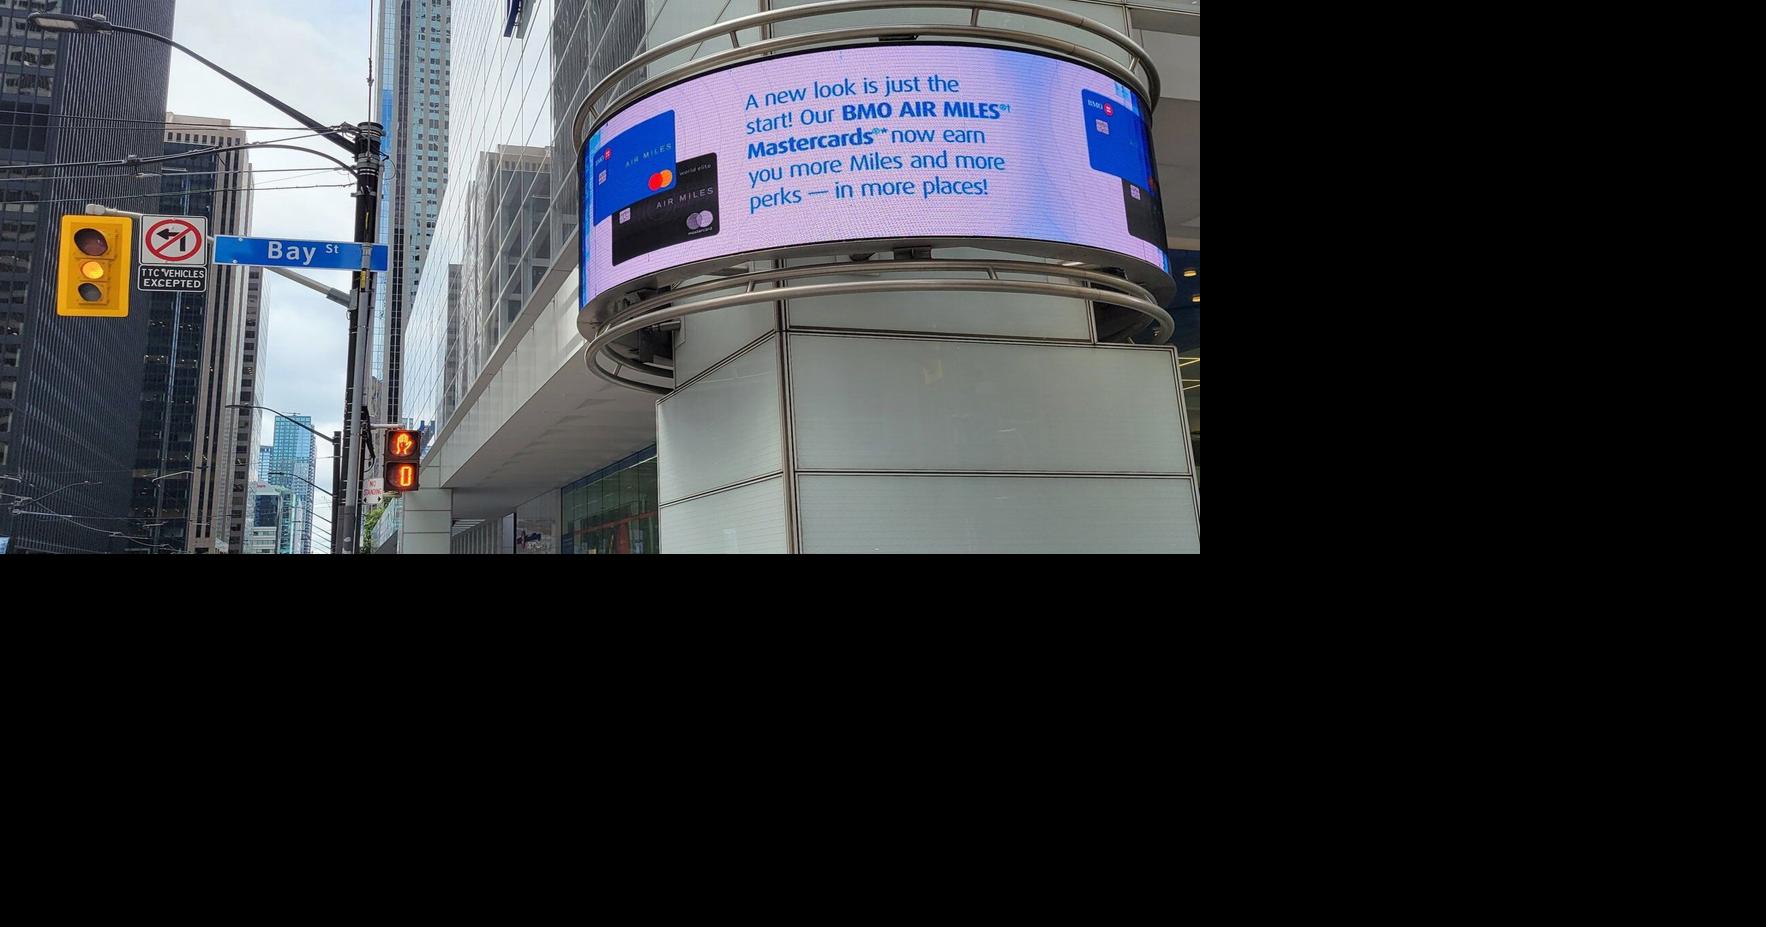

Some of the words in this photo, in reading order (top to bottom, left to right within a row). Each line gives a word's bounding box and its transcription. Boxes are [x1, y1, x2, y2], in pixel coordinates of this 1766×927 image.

[745, 94, 759, 111] A
[765, 87, 806, 106] new
[814, 78, 856, 99] look
[863, 77, 878, 94] is
[884, 75, 921, 97] just
[927, 74, 959, 93] the
[746, 111, 793, 135] start!
[800, 108, 835, 126] Our
[842, 101, 892, 122] BMO
[899, 101, 937, 118] AIR
[891, 128, 935, 144] now
[942, 128, 986, 144] earn
[625, 157, 639, 168] AIR
[643, 143, 672, 159] MILES
[679, 166, 696, 177] world
[748, 167, 783, 188] you
[789, 159, 842, 178] more
[849, 151, 903, 172] Miles
[910, 149, 948, 169] and
[955, 154, 1005, 171] more
[656, 198, 674, 209] AIR
[679, 187, 714, 202] MILES
[749, 187, 802, 214] perks
[835, 181, 853, 199] in
[861, 179, 915, 198] more
[922, 176, 989, 199] places!
[687, 226, 713, 236] mastercard
[267, 241, 316, 266] Bay
[325, 243, 339, 255] St
[141, 268, 160, 277] TTC
[163, 268, 205, 279] VEHICLES
[143, 279, 202, 289] EXCEPTED
[400, 466, 412, 487] 0
